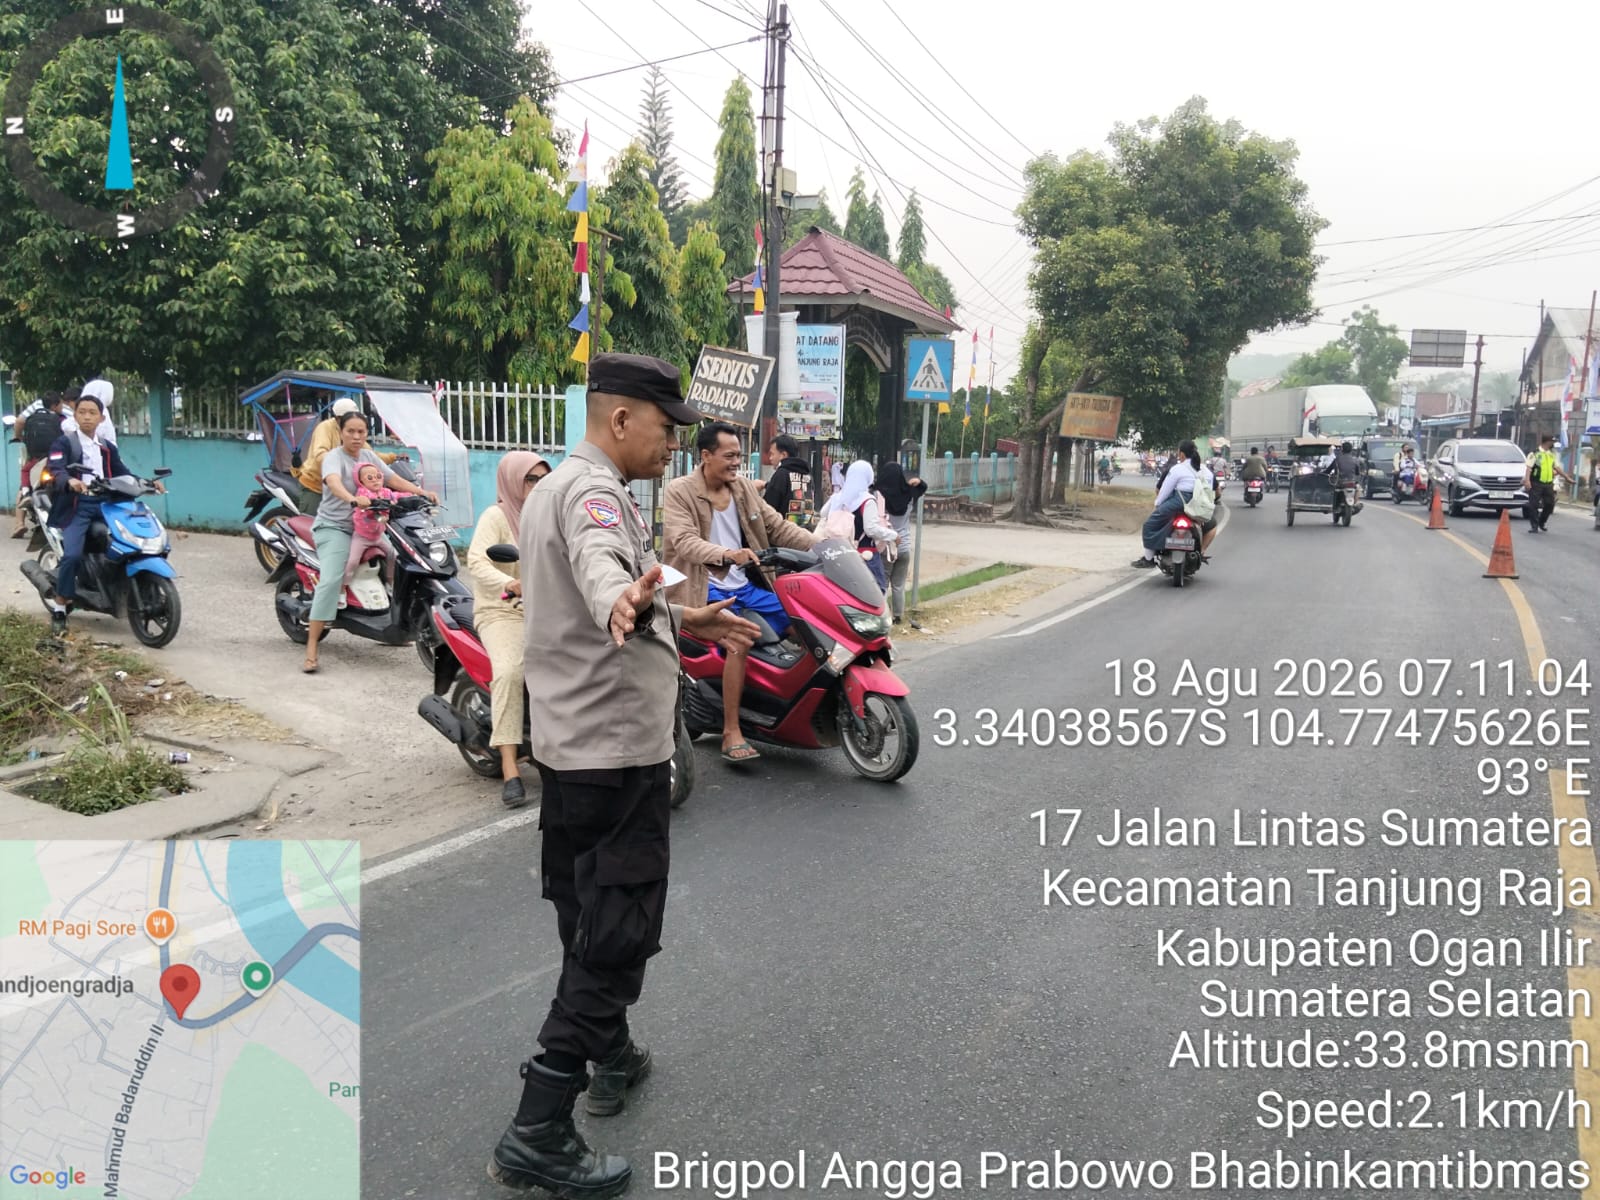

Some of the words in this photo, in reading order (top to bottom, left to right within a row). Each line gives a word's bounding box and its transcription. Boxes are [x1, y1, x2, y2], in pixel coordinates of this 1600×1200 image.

[808, 335, 839, 346] DATANG
[697, 354, 760, 389] SERVIS
[822, 357, 839, 367] RAJA
[690, 381, 749, 412] RADIATOR
